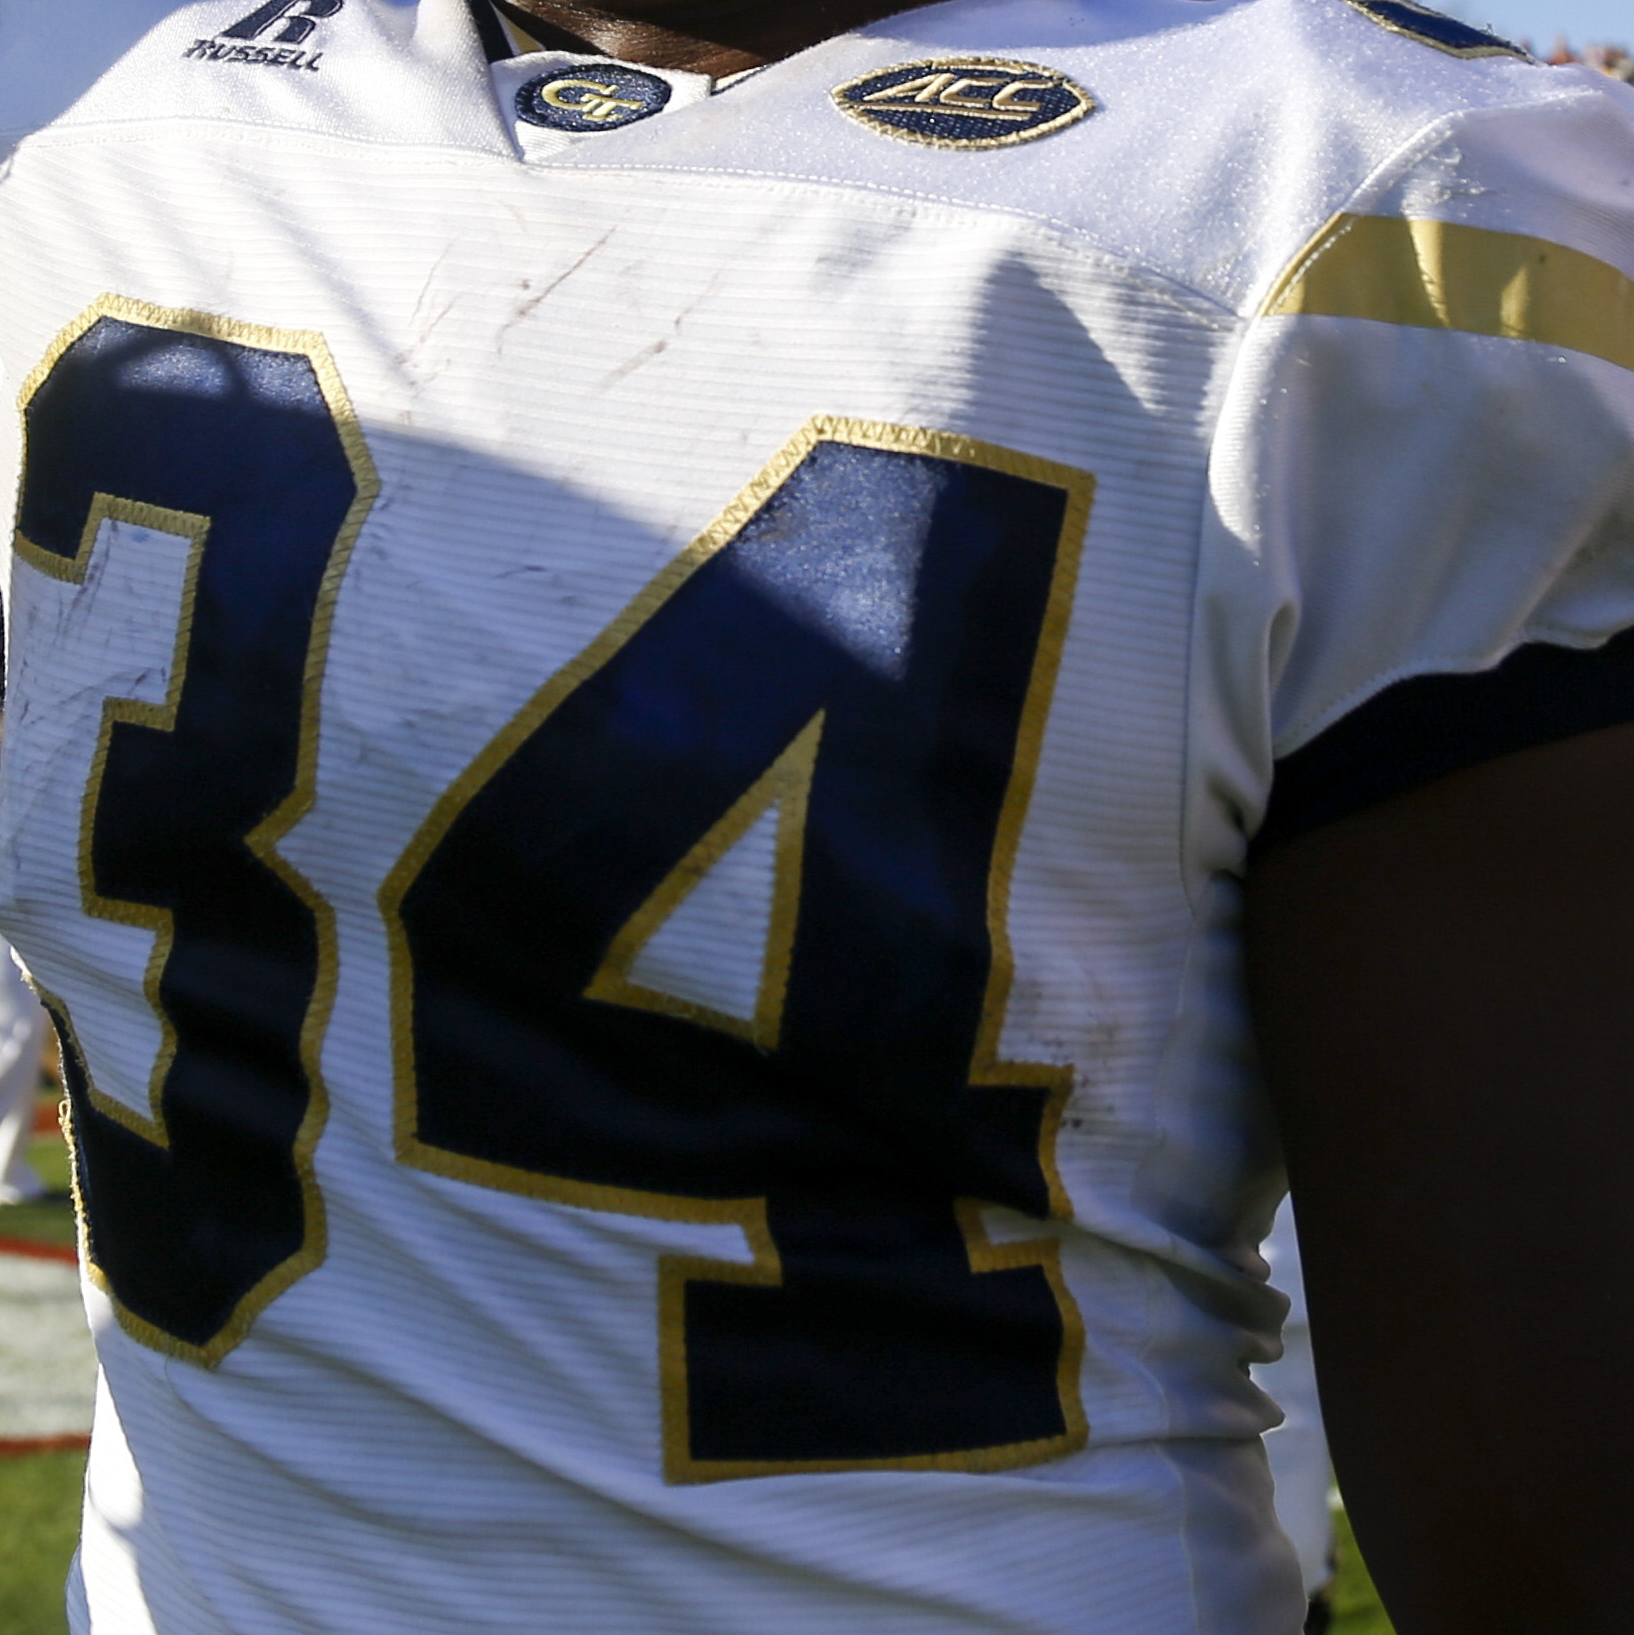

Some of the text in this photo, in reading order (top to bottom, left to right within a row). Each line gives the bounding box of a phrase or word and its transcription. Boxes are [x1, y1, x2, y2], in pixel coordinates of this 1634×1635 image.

[182, 38, 324, 72] RUSSELL
[863, 72, 1057, 112] ACC
[15, 292, 1098, 1485] 34
